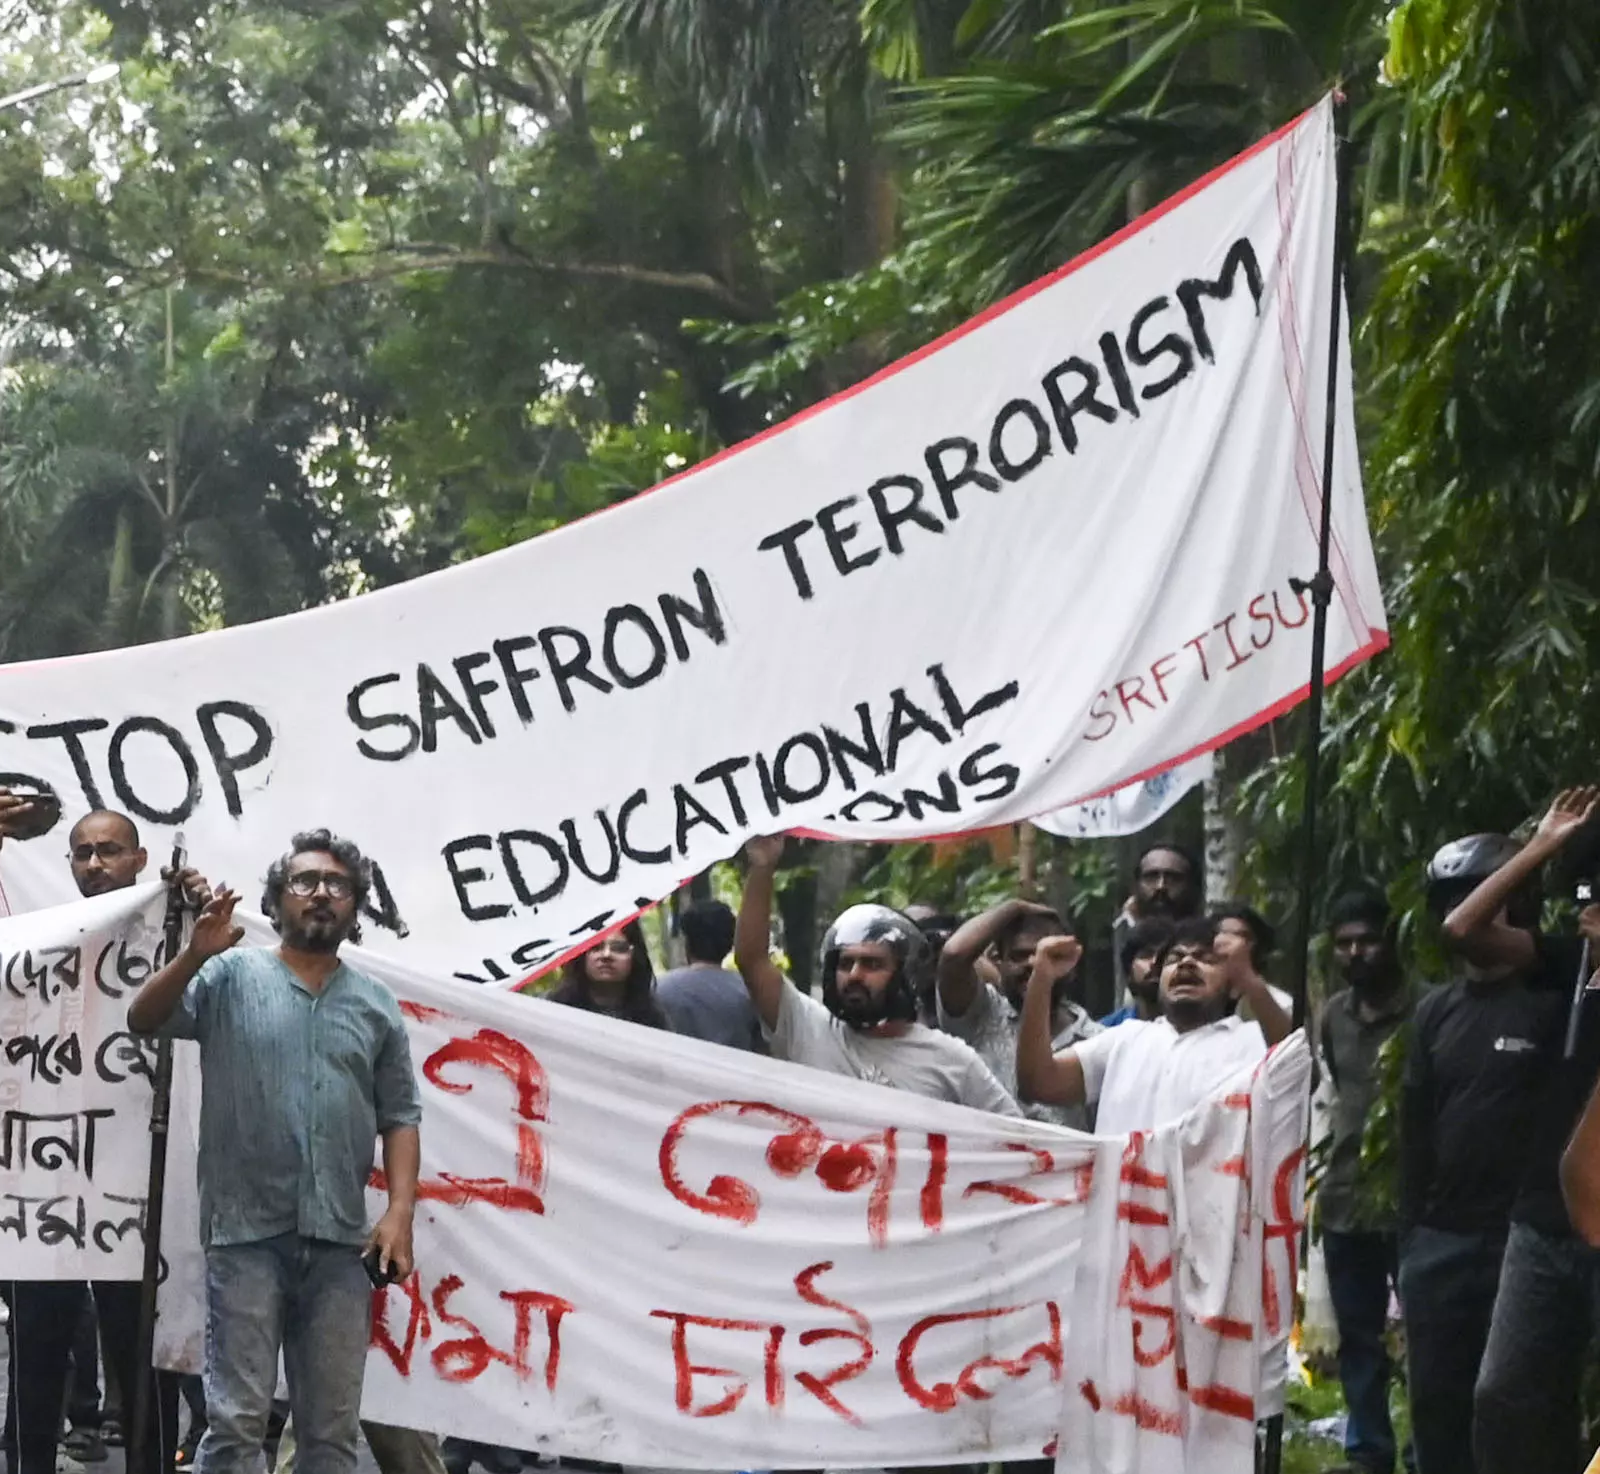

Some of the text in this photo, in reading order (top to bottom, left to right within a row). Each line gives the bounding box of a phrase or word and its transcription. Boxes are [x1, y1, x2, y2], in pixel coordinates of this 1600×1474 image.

[346, 568, 728, 763] SAFFRON
[757, 236, 1264, 602] TERRORISM
[443, 662, 1020, 922] EDUCATIONAL
[5, 1032, 83, 1085] পরে
[649, 1260, 1063, 1430] চাইলে
